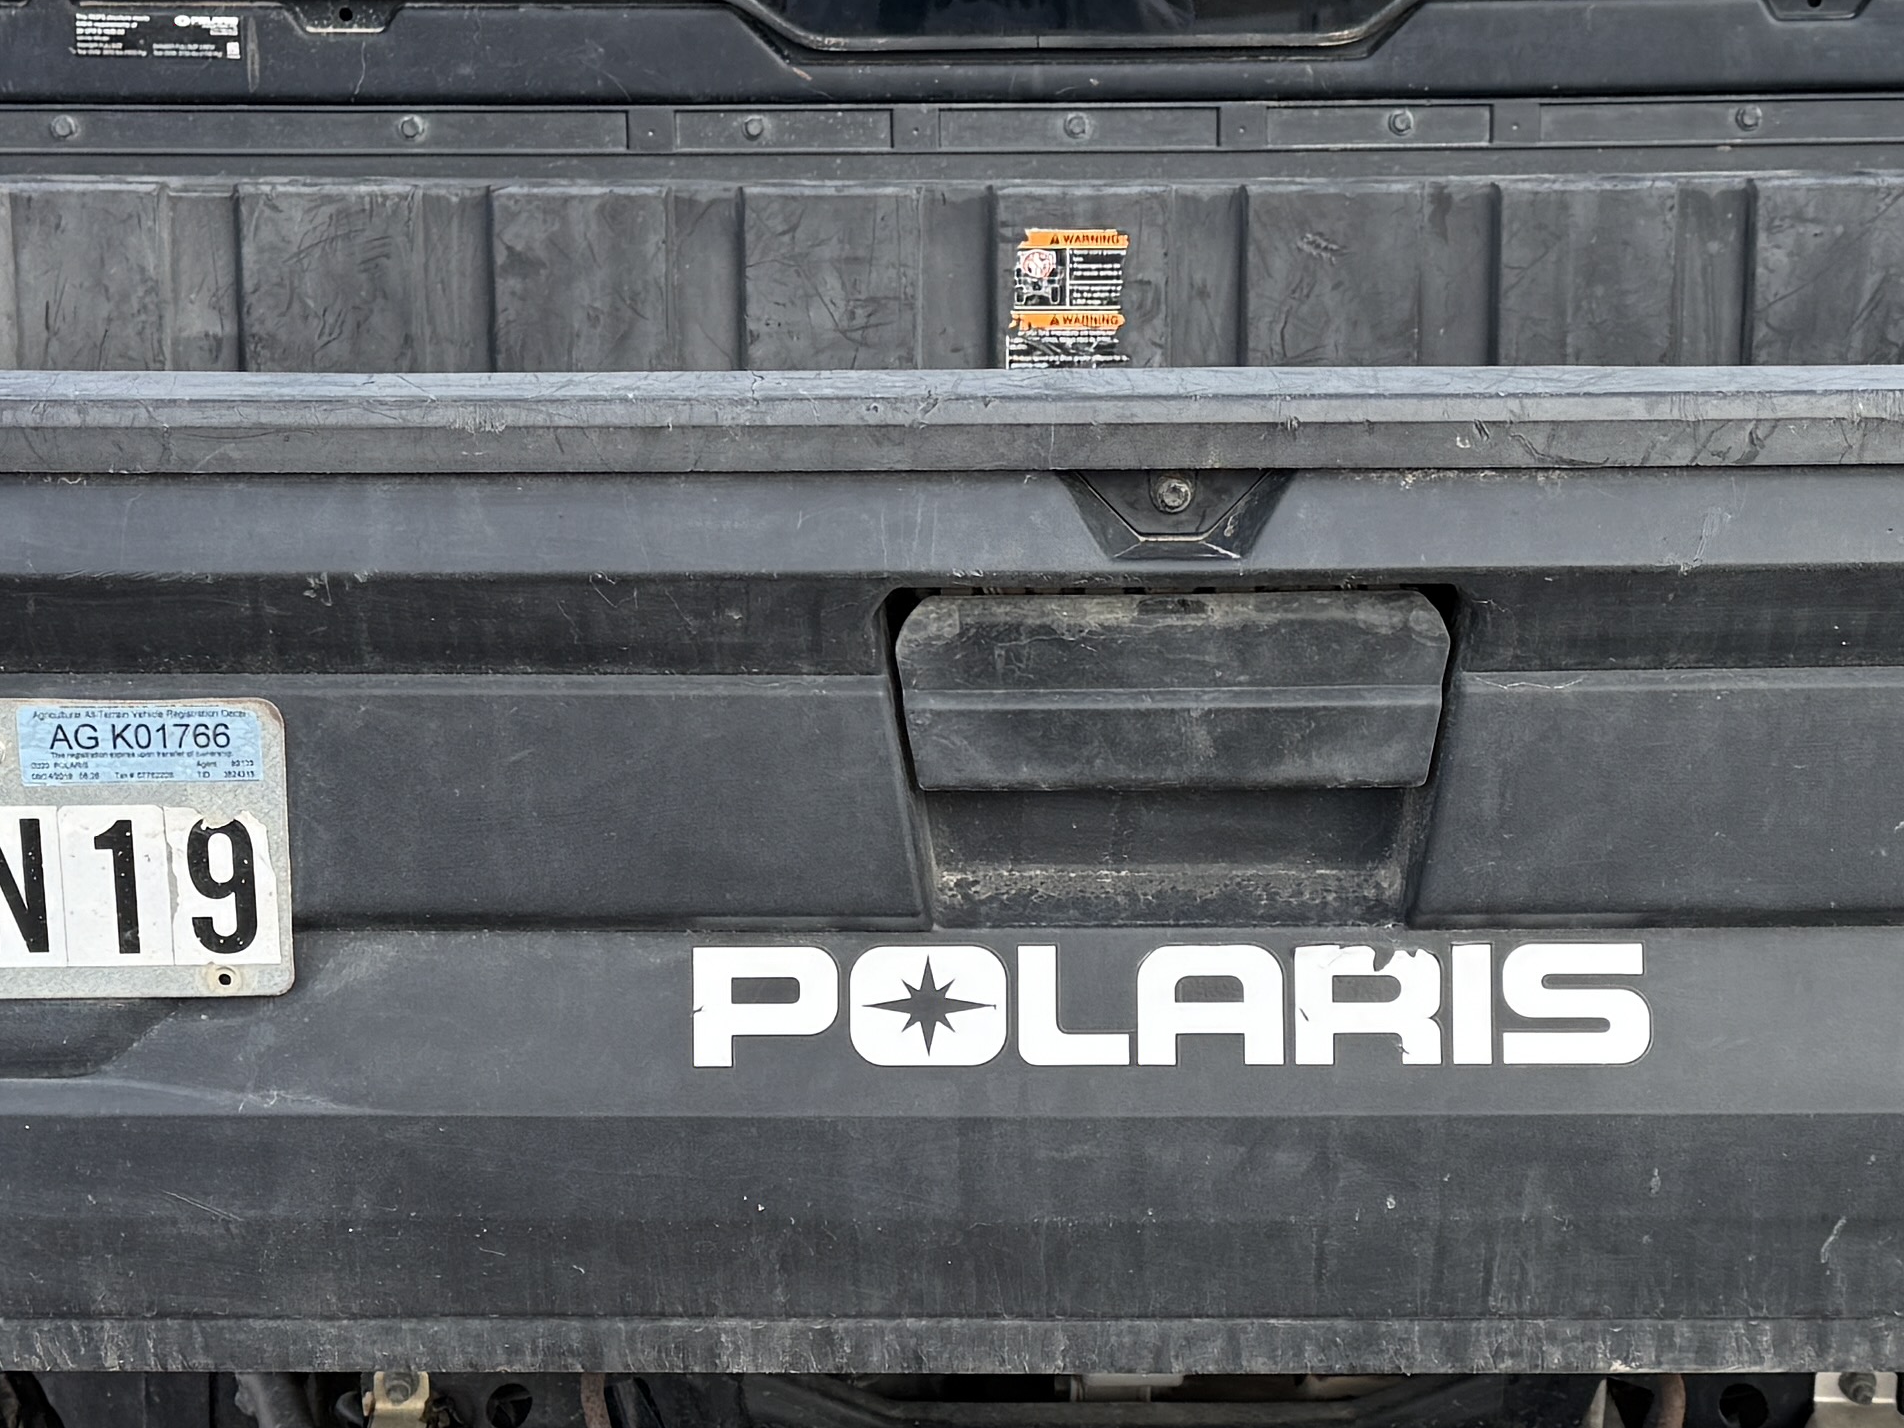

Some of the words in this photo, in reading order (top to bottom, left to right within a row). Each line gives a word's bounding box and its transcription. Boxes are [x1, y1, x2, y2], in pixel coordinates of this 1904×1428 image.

[1062, 234, 1120, 245] WARNING
[1062, 314, 1119, 326] WARNING
[50, 723, 100, 750] AG
[112, 723, 231, 750] K01766
[691, 943, 1653, 1068] POLARIS
